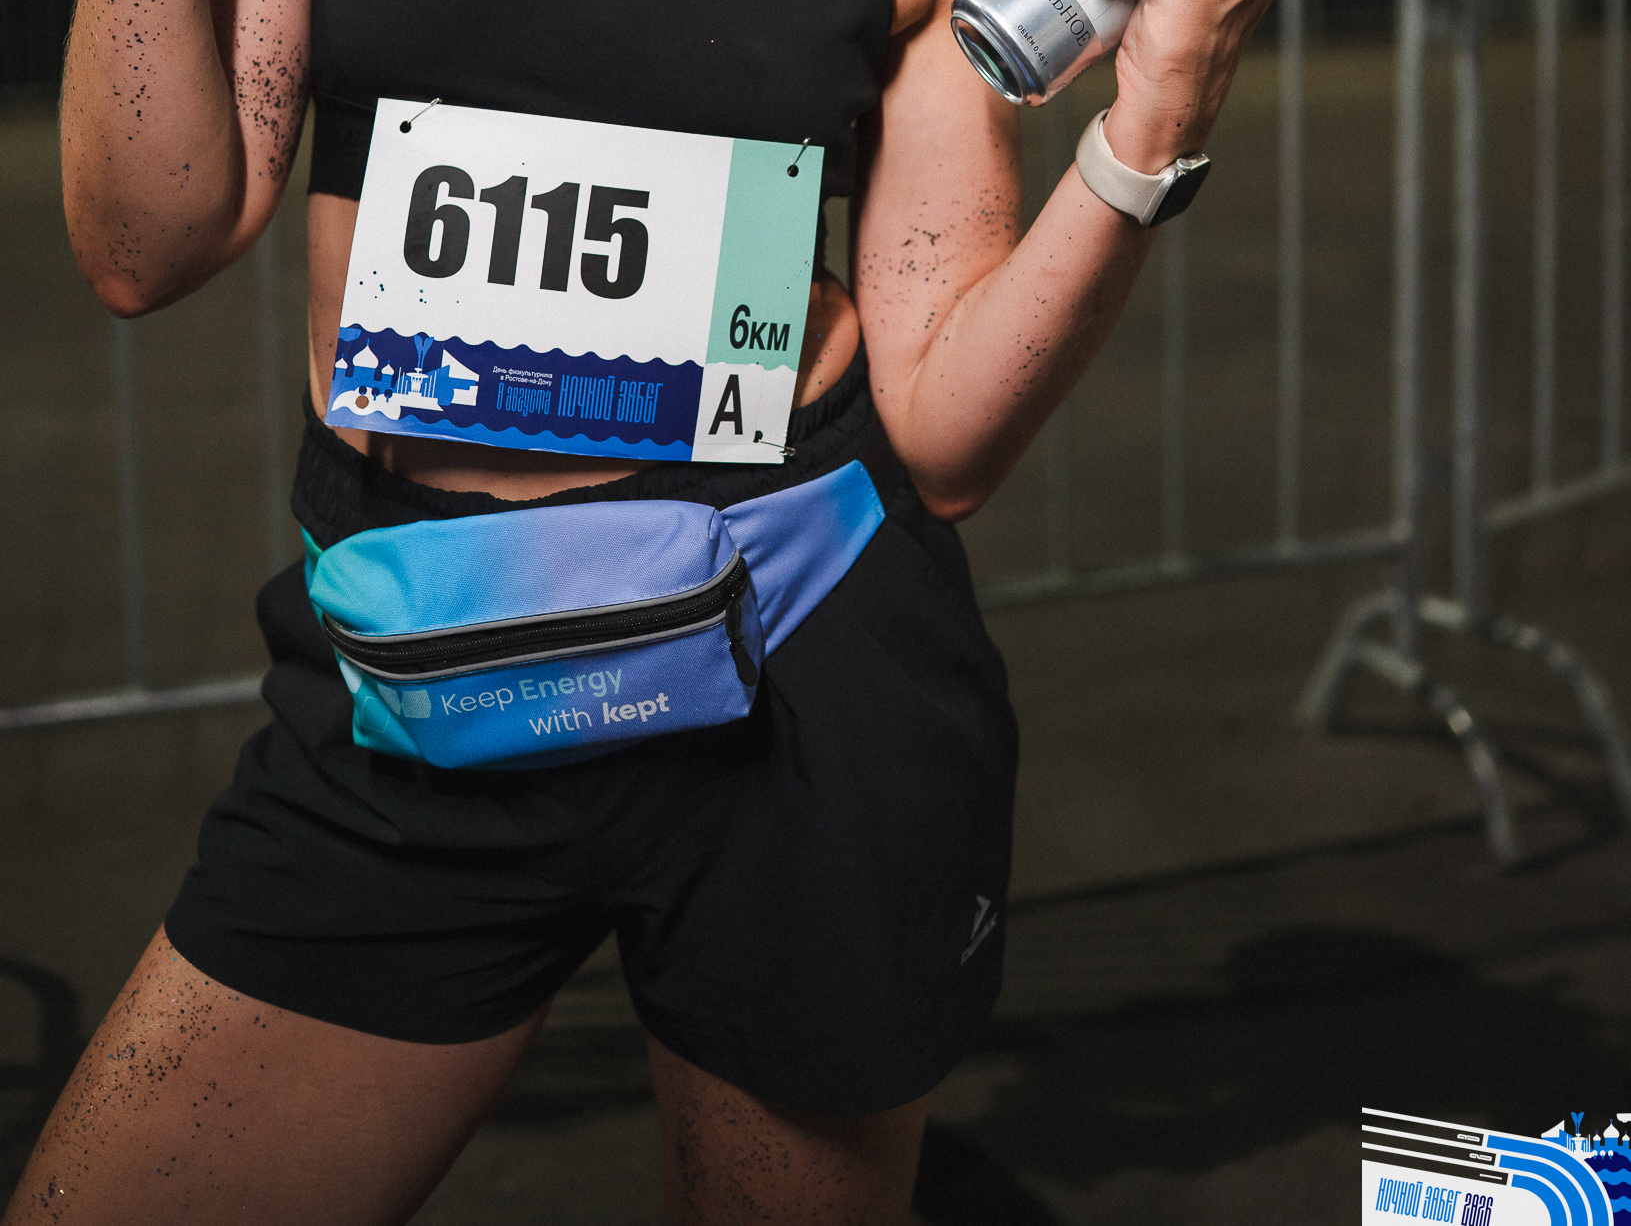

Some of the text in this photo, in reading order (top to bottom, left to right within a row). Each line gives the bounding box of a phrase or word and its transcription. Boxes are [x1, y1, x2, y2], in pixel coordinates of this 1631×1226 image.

[1033, 46, 1044, 63] 0,45
[403, 164, 650, 300] 6115
[492, 365, 553, 379] День физкультурника
[505, 375, 553, 387] Ростове-на-Дону
[496, 382, 552, 418] 8 августа
[557, 374, 664, 424] НОЧНОЙ ЗАБЕГ
[442, 668, 623, 717] Keep Energy
[528, 693, 670, 737] with kept
